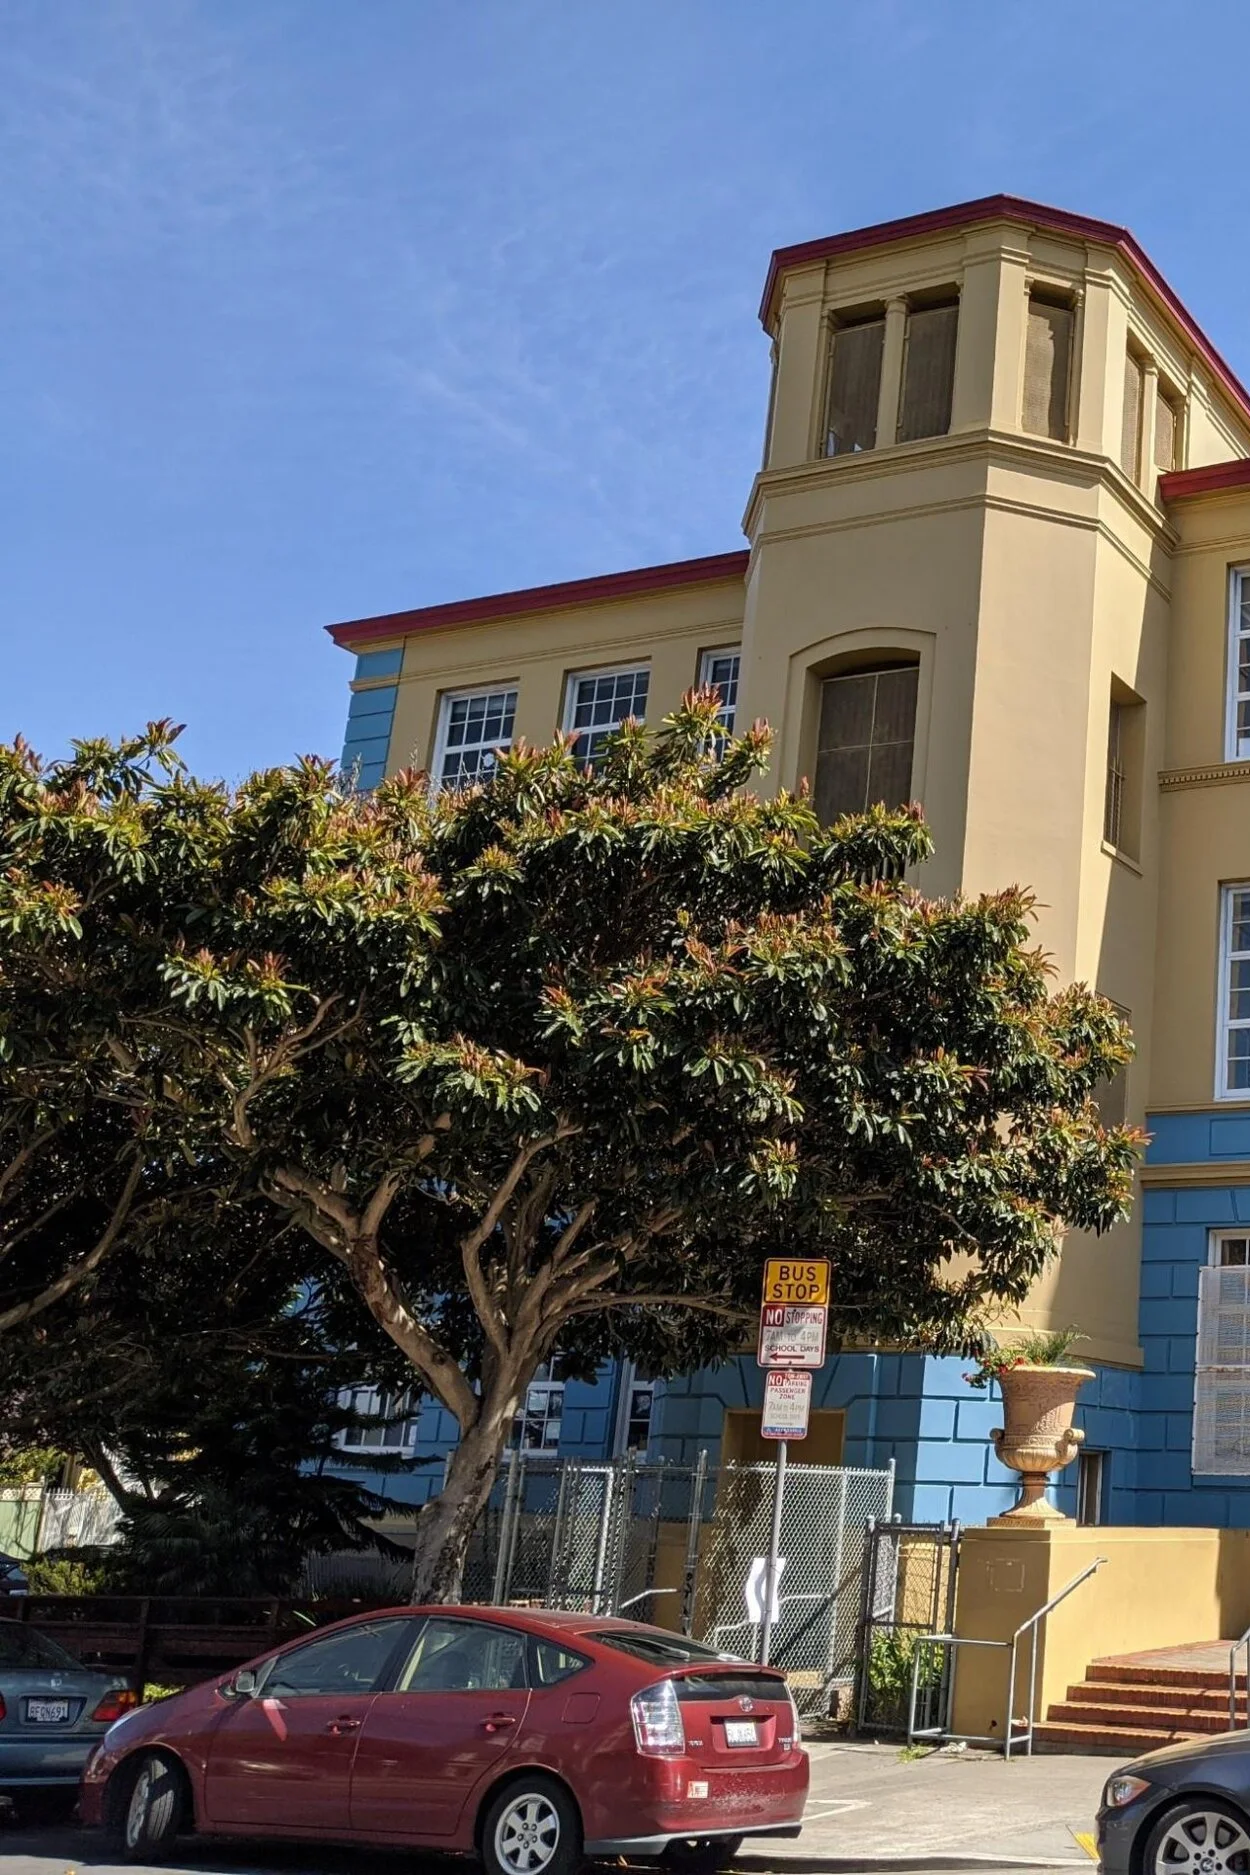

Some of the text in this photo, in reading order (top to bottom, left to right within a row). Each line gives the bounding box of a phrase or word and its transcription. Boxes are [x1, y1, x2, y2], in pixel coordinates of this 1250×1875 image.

[779, 1265, 816, 1281] BUS
[772, 1283, 820, 1300] STOP
[765, 1309, 823, 1325] NO STOPPING
[765, 1329, 819, 1342] 7AM TO 4PM
[764, 1344, 820, 1353] SCHOOL DAYS
[768, 1374, 783, 1386] NO
